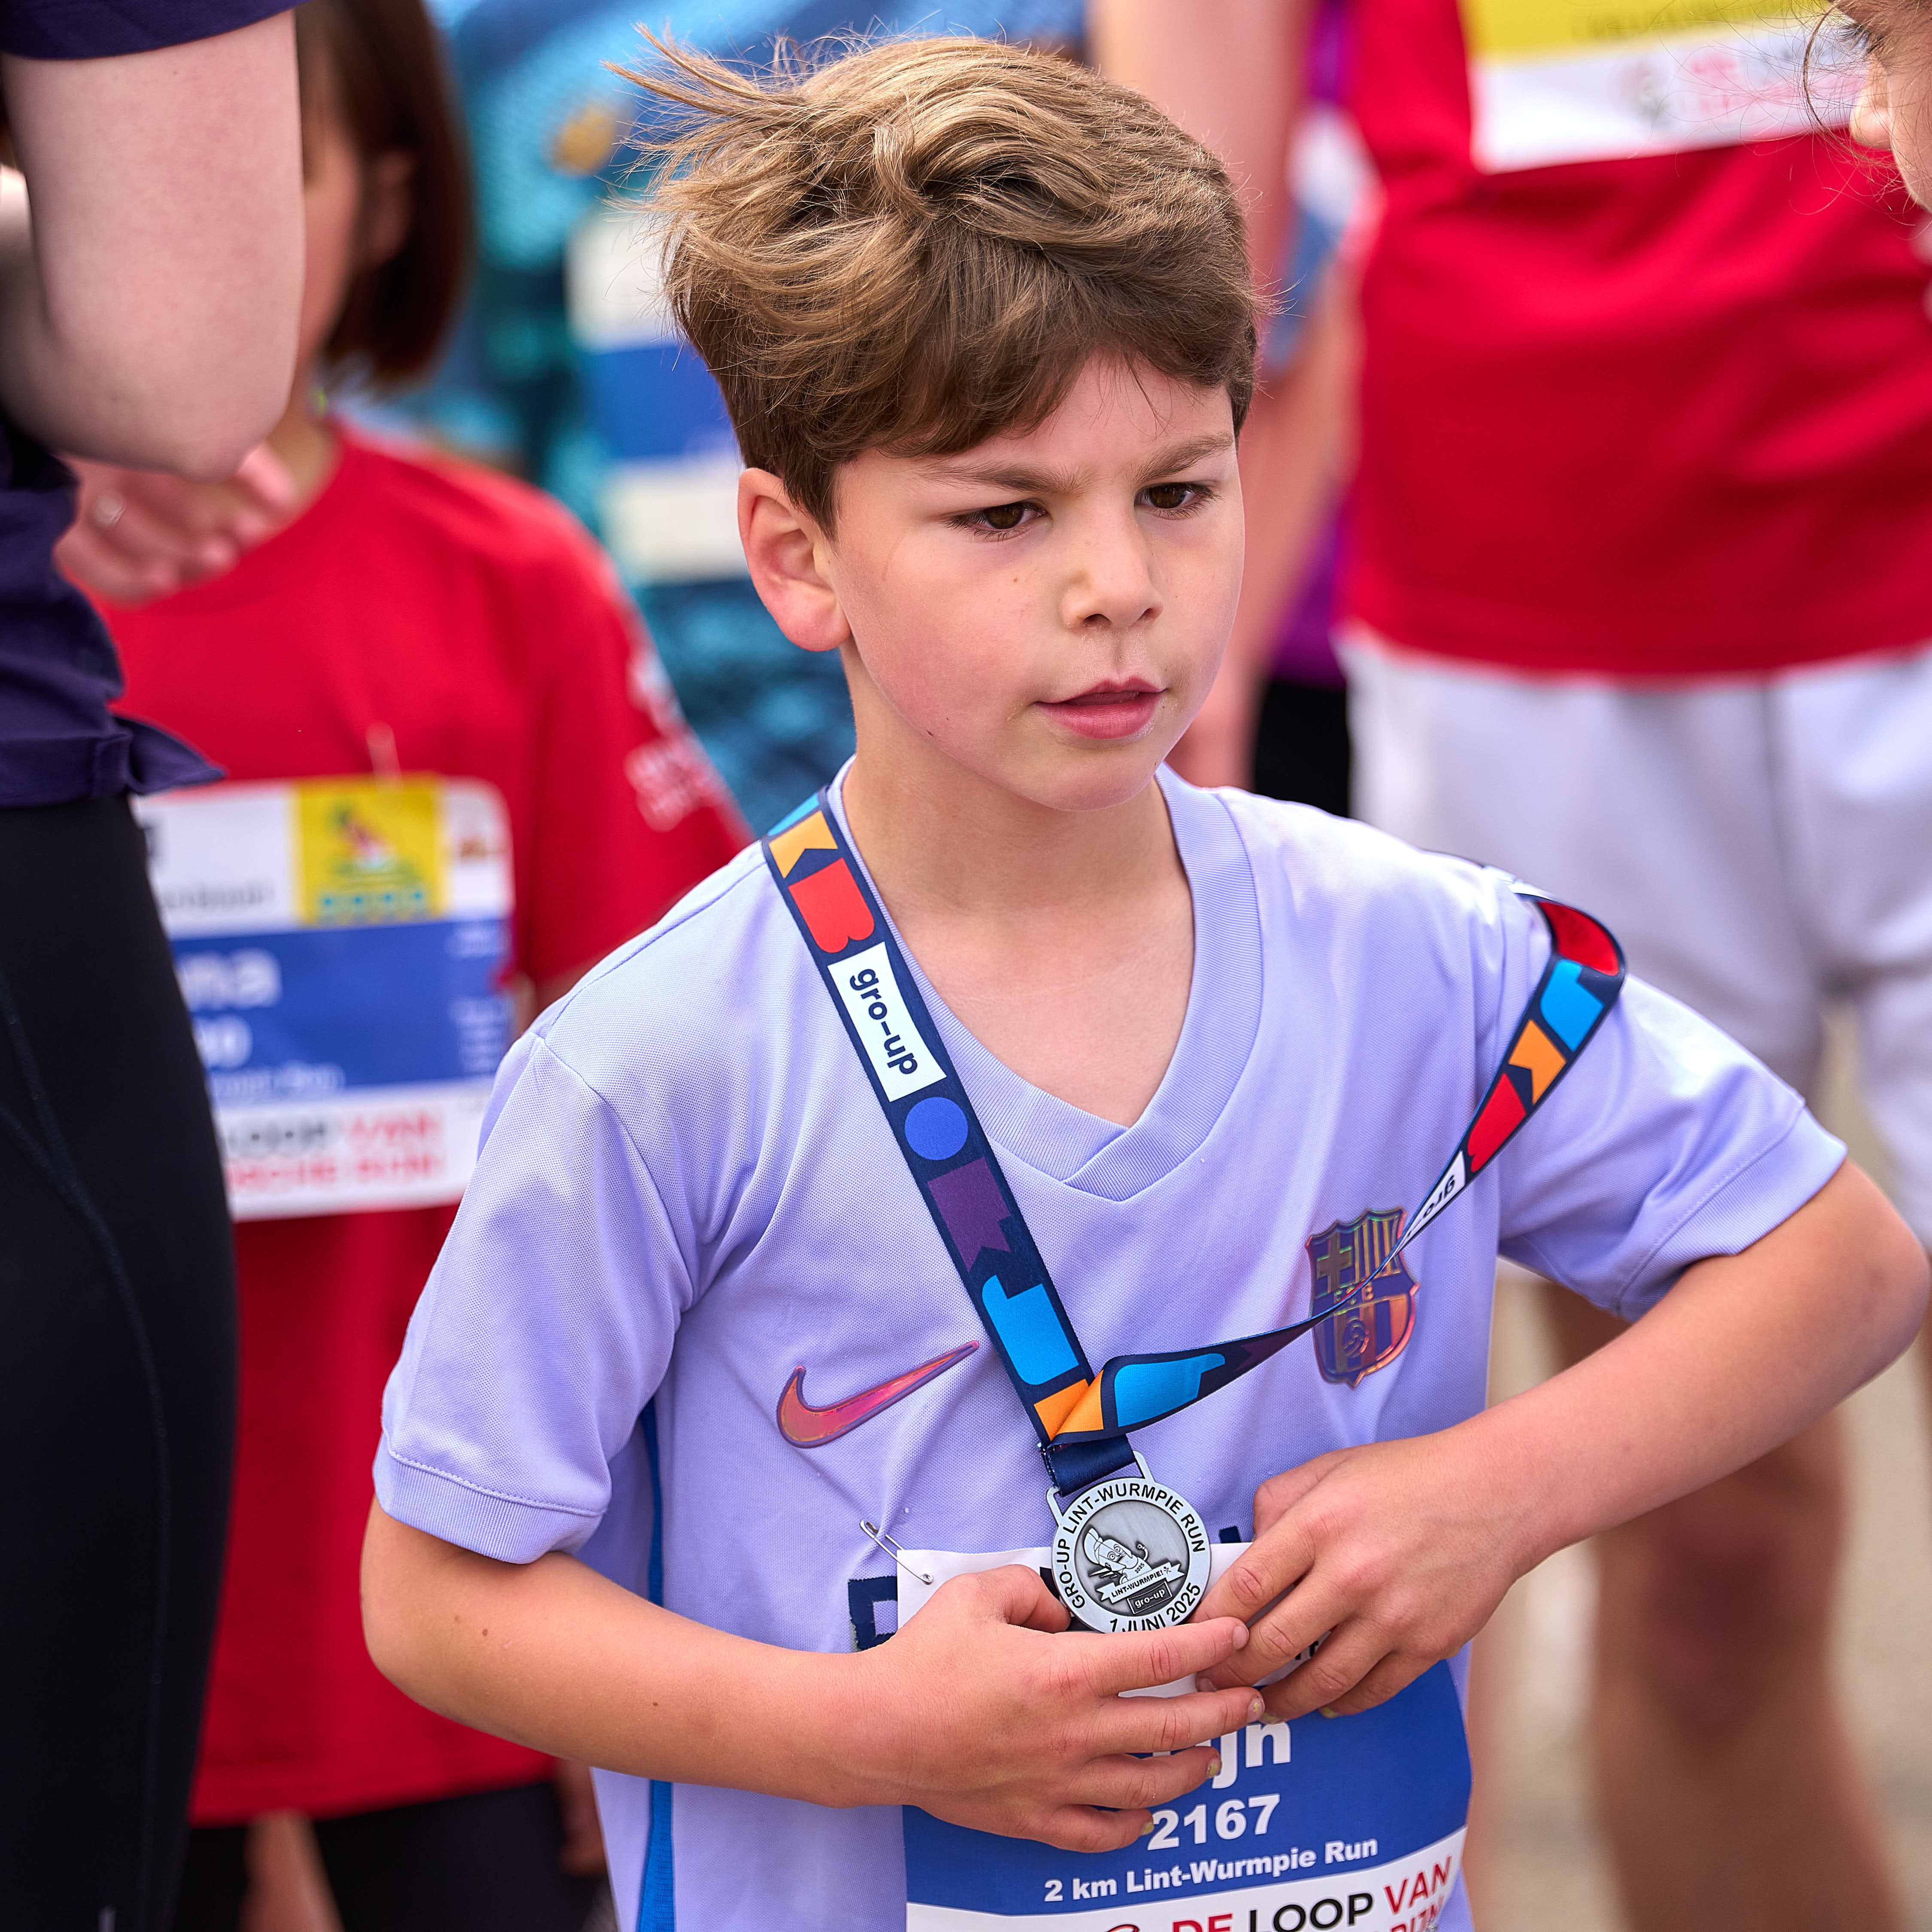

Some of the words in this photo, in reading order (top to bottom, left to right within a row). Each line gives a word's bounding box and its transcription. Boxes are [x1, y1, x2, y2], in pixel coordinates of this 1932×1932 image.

[850, 969, 918, 1075] gro-up
[1063, 1483, 1184, 1534] LINT-WURMPIE
[1180, 1513, 1206, 1553] RUN
[1057, 1538, 1085, 1609] GRO-UP
[1111, 1570, 1164, 1598] LINT-WURMPIE!
[1135, 1563, 1145, 1574] 2025
[1109, 1618, 1118, 1632] 1
[1122, 1613, 1166, 1632] JUNI
[1166, 1582, 1200, 1622] 2025
[1134, 1589, 1165, 1608] gro-up
[1147, 1792, 1281, 1851] 2167
[1044, 1879, 1063, 1902] 2
[1072, 1876, 1118, 1901] km
[1126, 1846, 1317, 1893] Lint-Wurmpie
[1324, 1838, 1379, 1865] Run
[1249, 1893, 1373, 1932] LOOP
[1383, 1855, 1452, 1915] VAN
